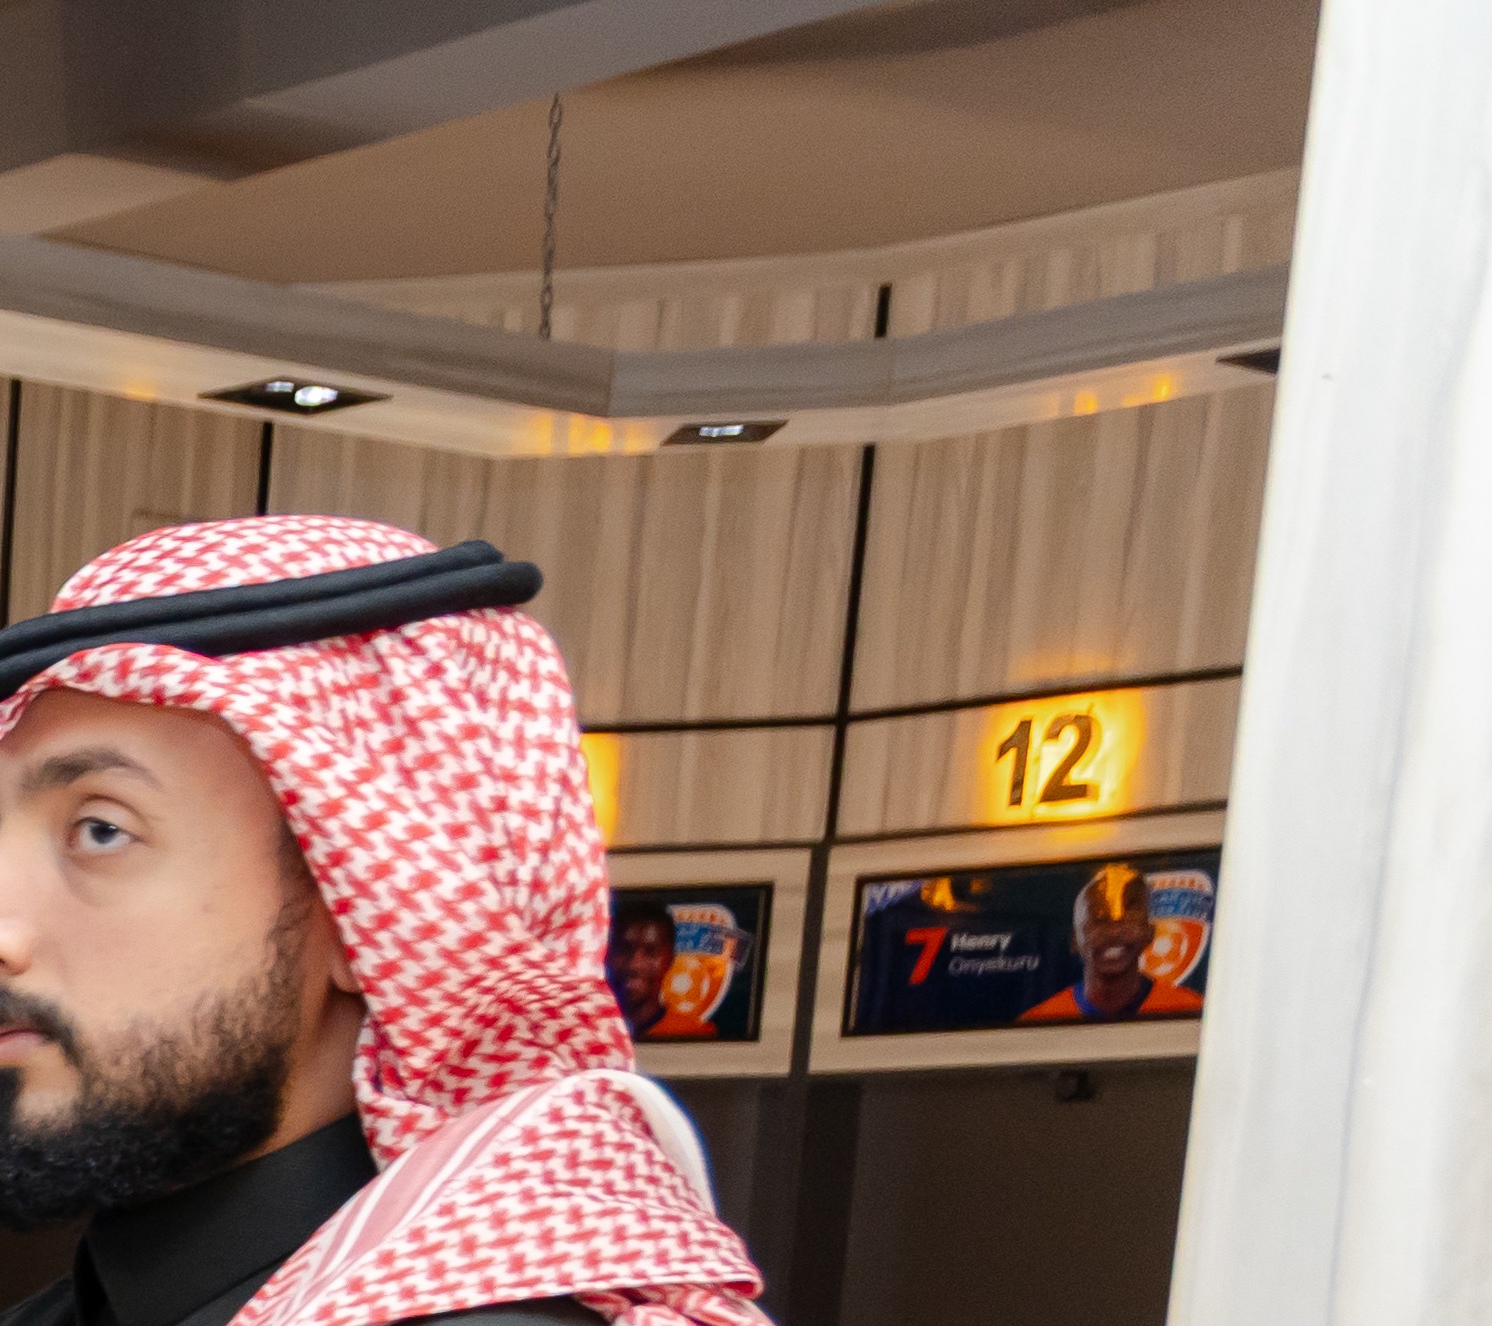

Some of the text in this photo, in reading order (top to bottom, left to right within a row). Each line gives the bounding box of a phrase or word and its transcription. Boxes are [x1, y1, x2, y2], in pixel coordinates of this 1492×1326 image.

[995, 714, 1094, 808] 12
[904, 926, 949, 987] 7
[949, 931, 1014, 956] Henry
